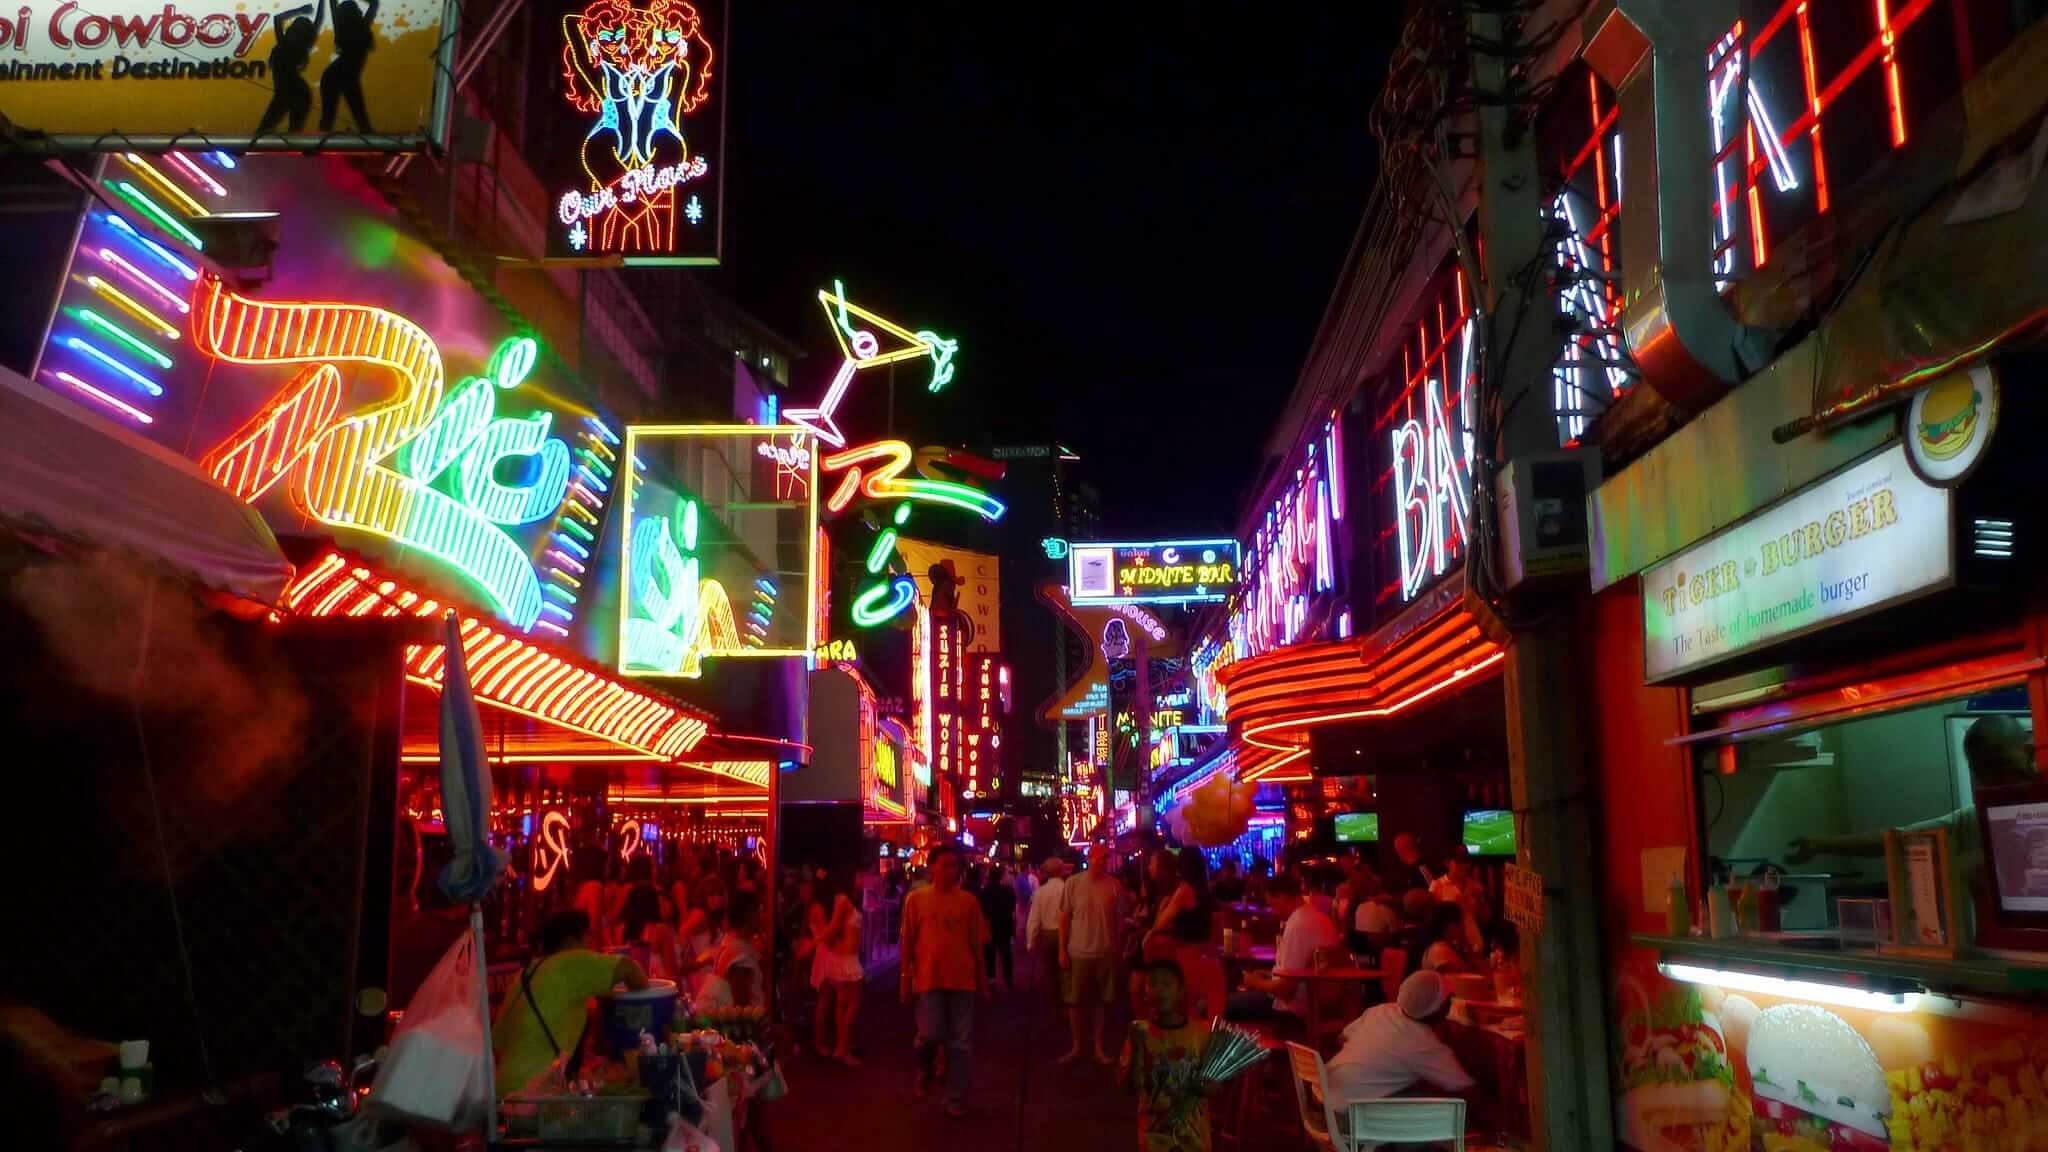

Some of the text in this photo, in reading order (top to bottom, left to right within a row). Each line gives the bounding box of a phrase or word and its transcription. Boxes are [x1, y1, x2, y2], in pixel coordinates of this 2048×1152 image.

[49, 1, 270, 57] Cowboy
[111, 54, 266, 80] Destination
[1760, 488, 1900, 577] BURGER
[1120, 563, 1233, 587] MIDNITE BAR
[1673, 571, 1870, 656] The Taste of homemade burger
[938, 625, 950, 698] SUZIE
[980, 658, 991, 729] SUZIE
